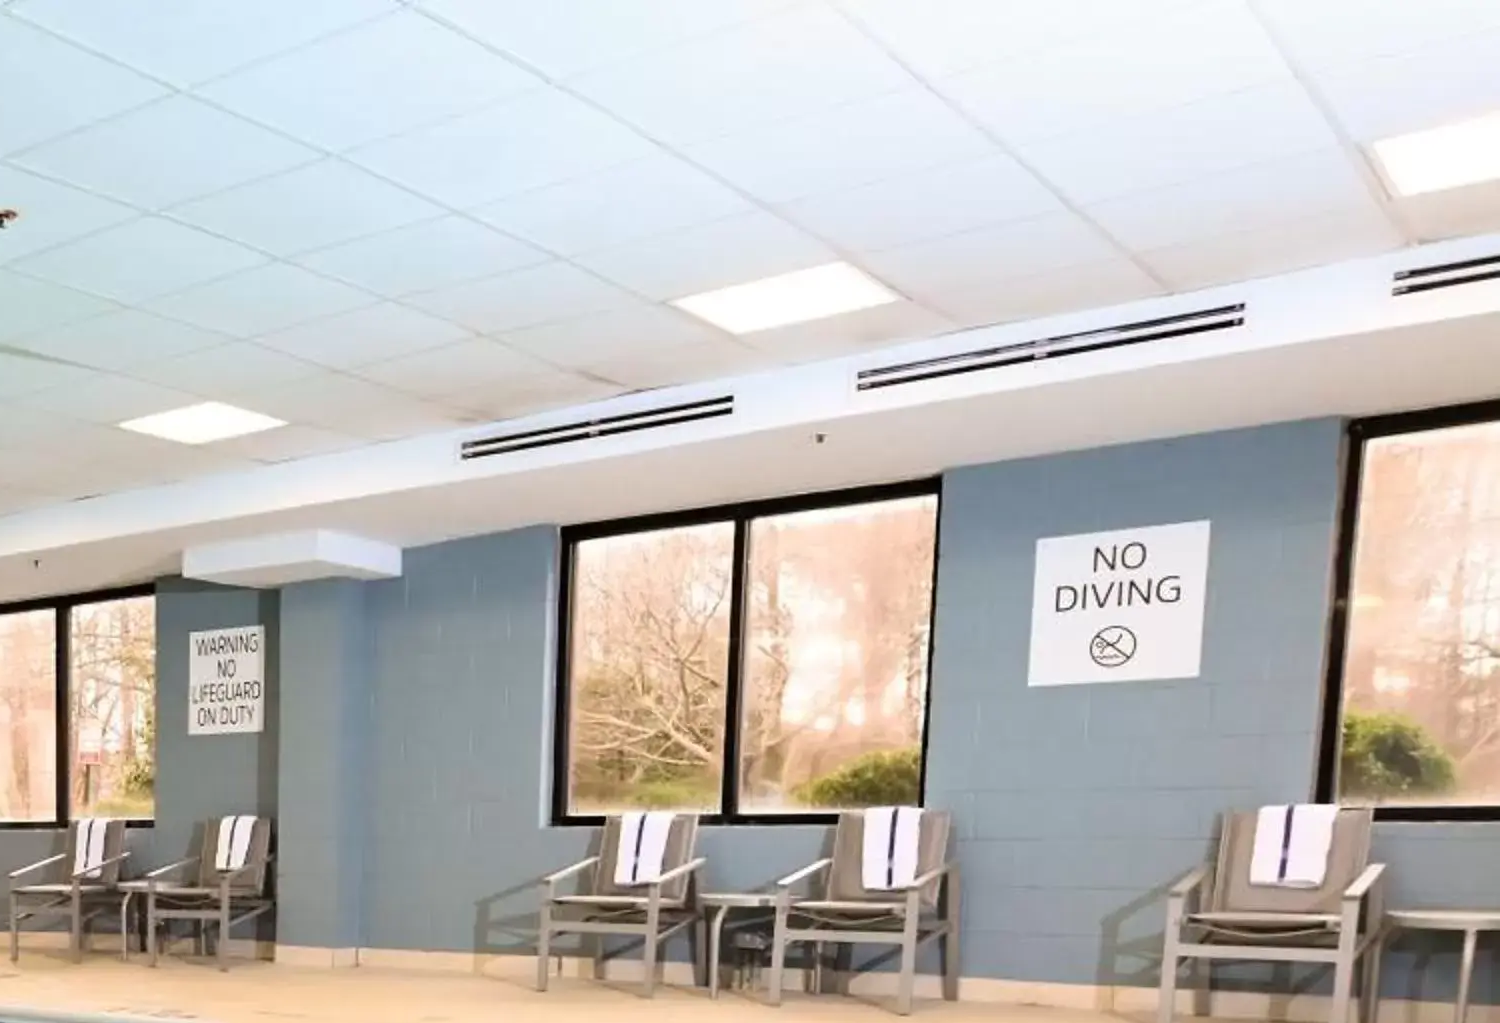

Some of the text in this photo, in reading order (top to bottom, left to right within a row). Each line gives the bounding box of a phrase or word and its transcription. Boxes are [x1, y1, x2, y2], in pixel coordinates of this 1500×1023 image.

[1092, 541, 1147, 573] NO
[1055, 575, 1182, 613] DIVING
[196, 633, 260, 656] WARNING
[217, 659, 237, 678] NO
[191, 680, 261, 704] LIFEGUARD
[197, 705, 255, 727] ON DUTY
